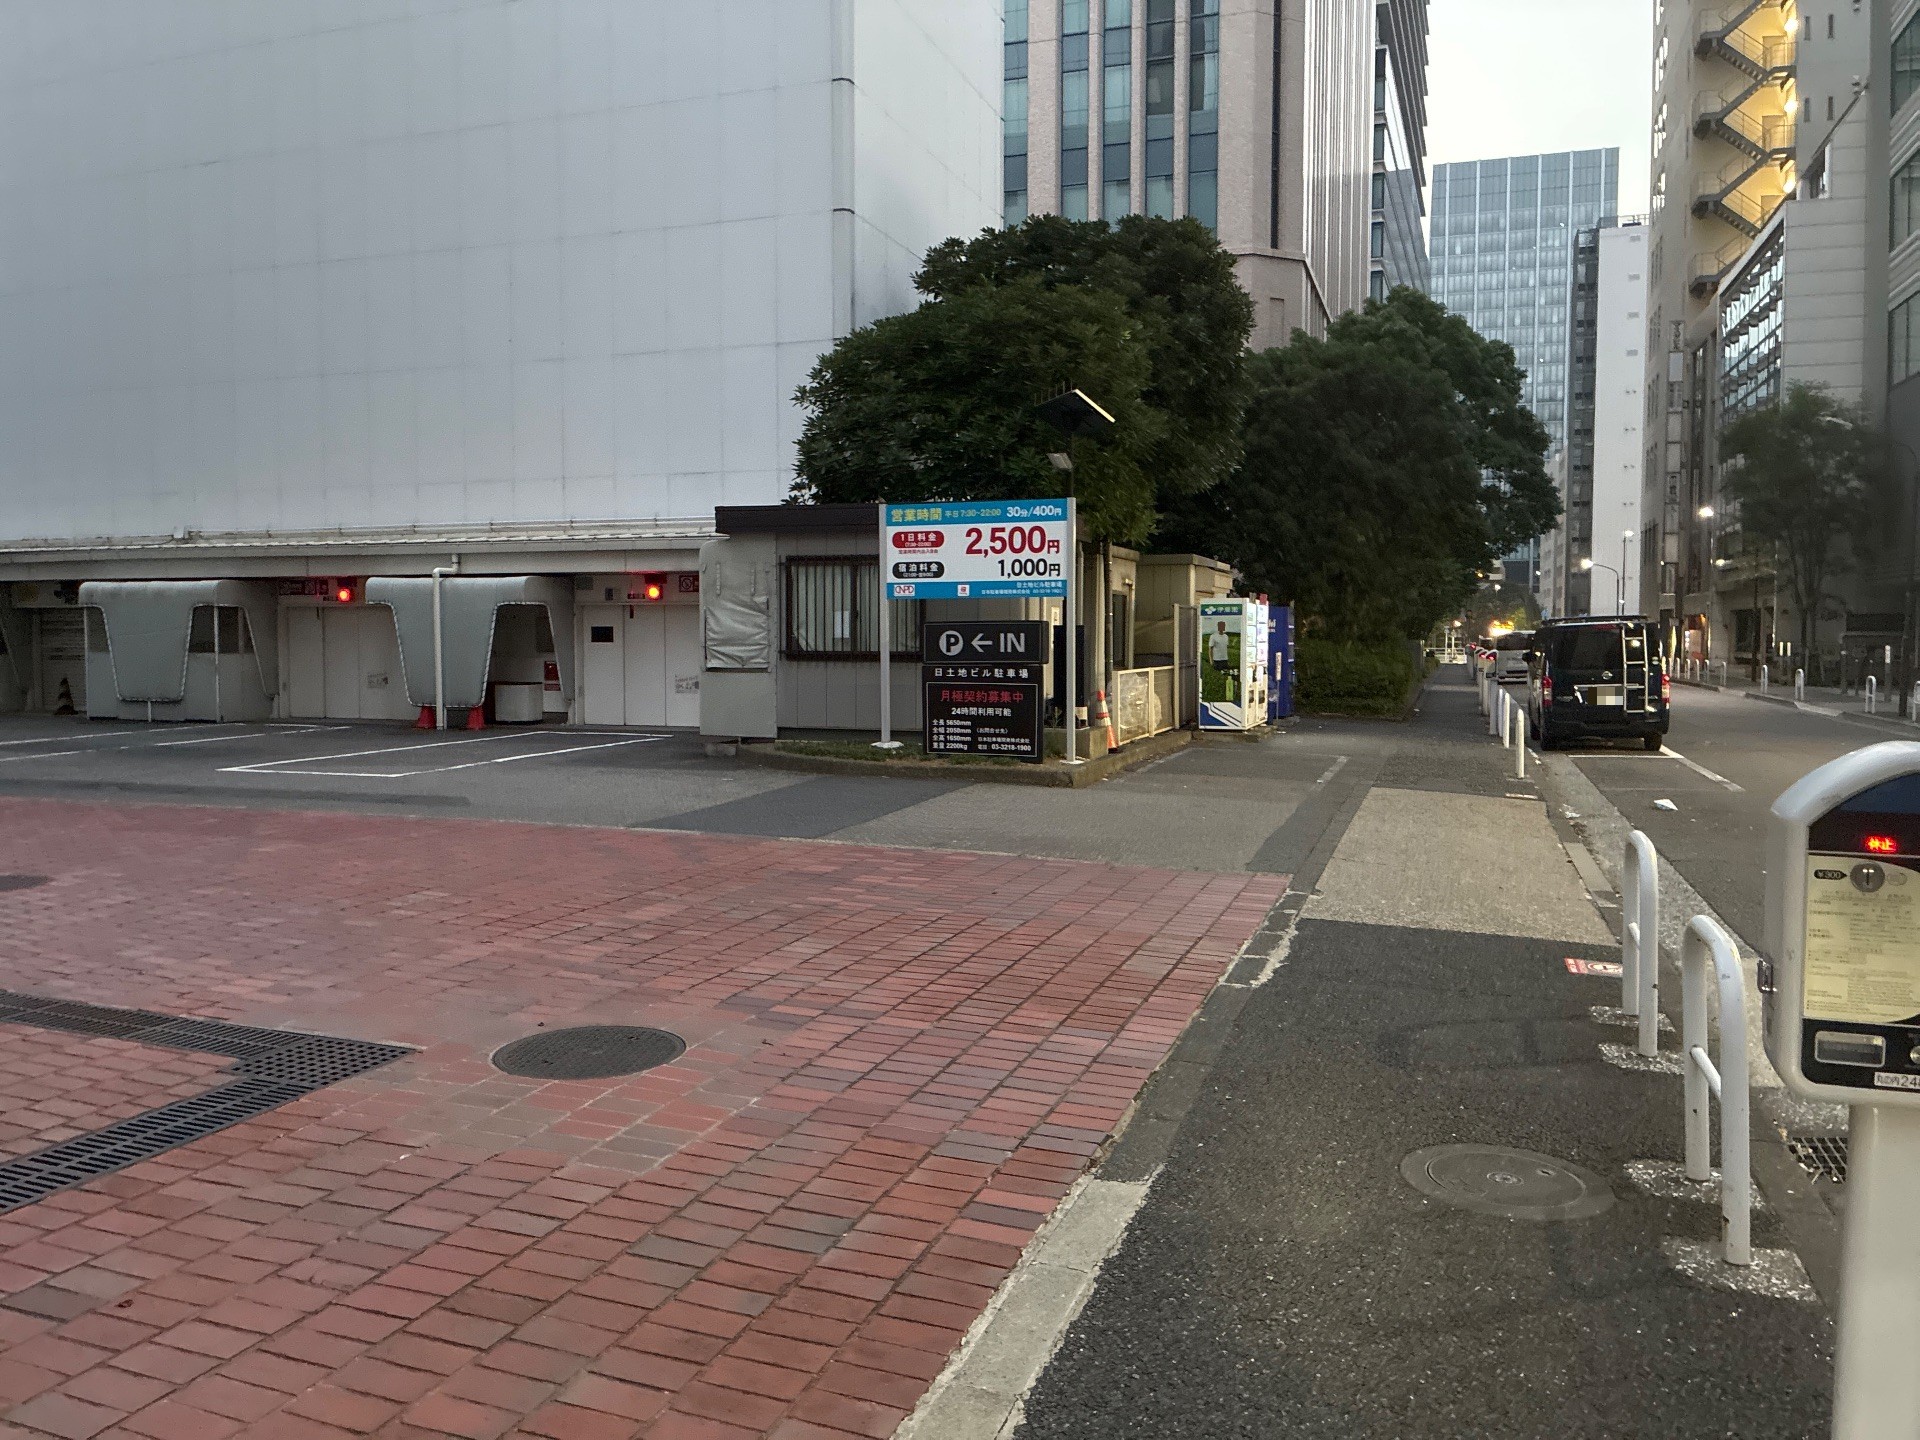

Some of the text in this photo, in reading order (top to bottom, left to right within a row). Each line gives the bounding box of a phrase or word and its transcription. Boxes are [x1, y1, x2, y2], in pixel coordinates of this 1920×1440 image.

[891, 508, 942, 522] 営業時間
[1006, 505, 1062, 518] 30分/400円
[965, 525, 1060, 558] 2,500円
[898, 562, 939, 573] 宿泊料金
[998, 558, 1061, 578] 1,000円
[999, 632, 1026, 653] IN
[934, 668, 1029, 679] 日土地ビル駐車場
[940, 690, 1024, 703] 月極契約募集中
[951, 707, 1012, 717] 24時間利用可能
